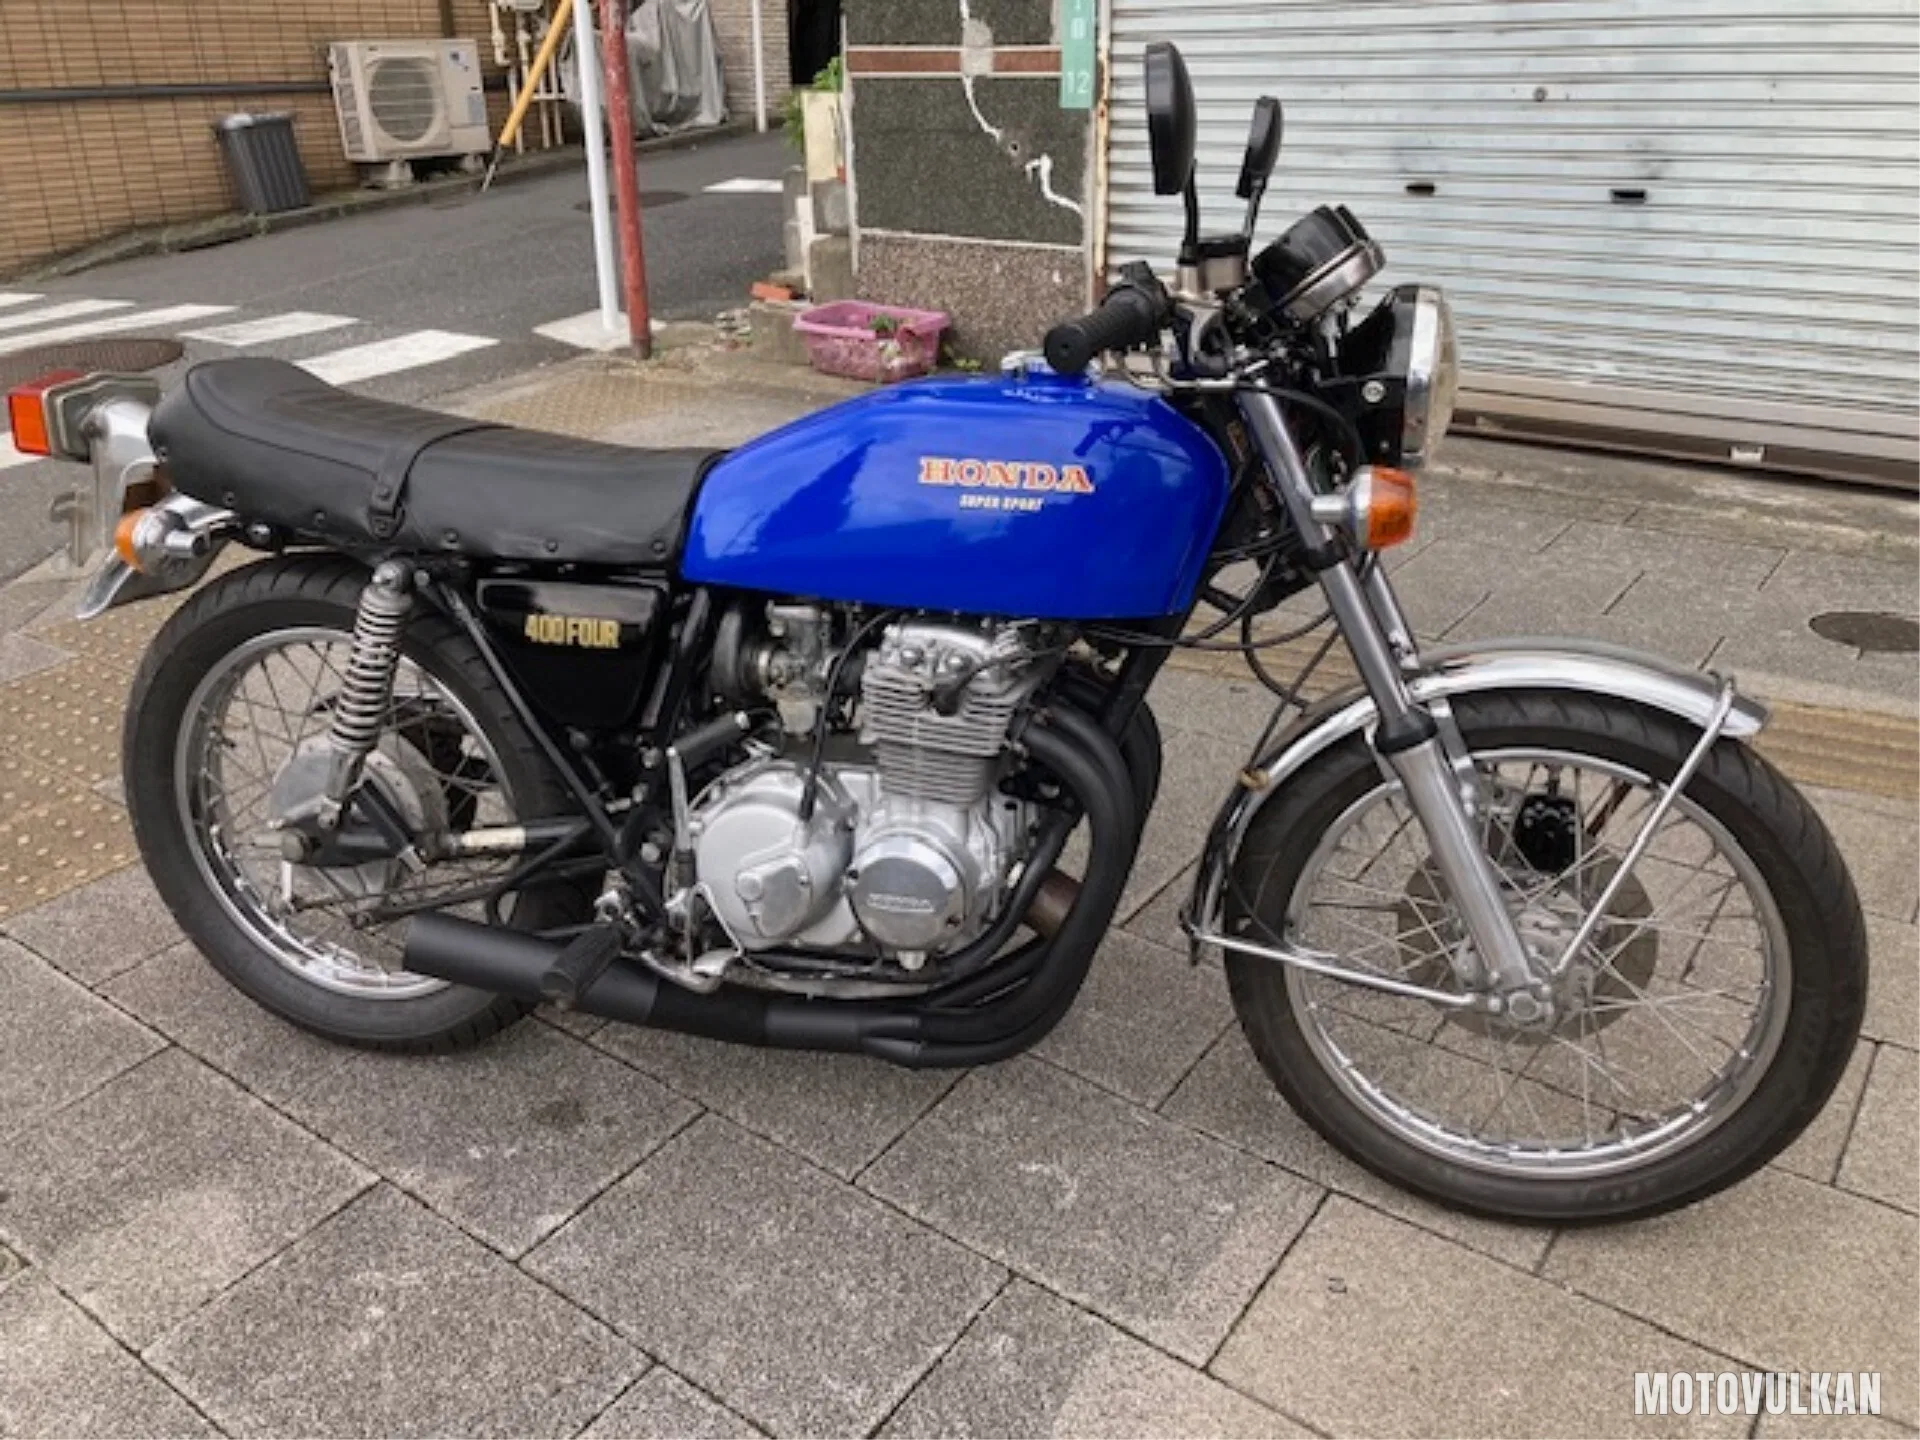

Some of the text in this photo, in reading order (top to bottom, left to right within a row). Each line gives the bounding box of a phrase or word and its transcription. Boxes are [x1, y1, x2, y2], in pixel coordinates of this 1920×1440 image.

[1066, 71, 1091, 95] 12
[919, 456, 1095, 494] HONDA
[959, 493, 1044, 512] SUPER SPORT
